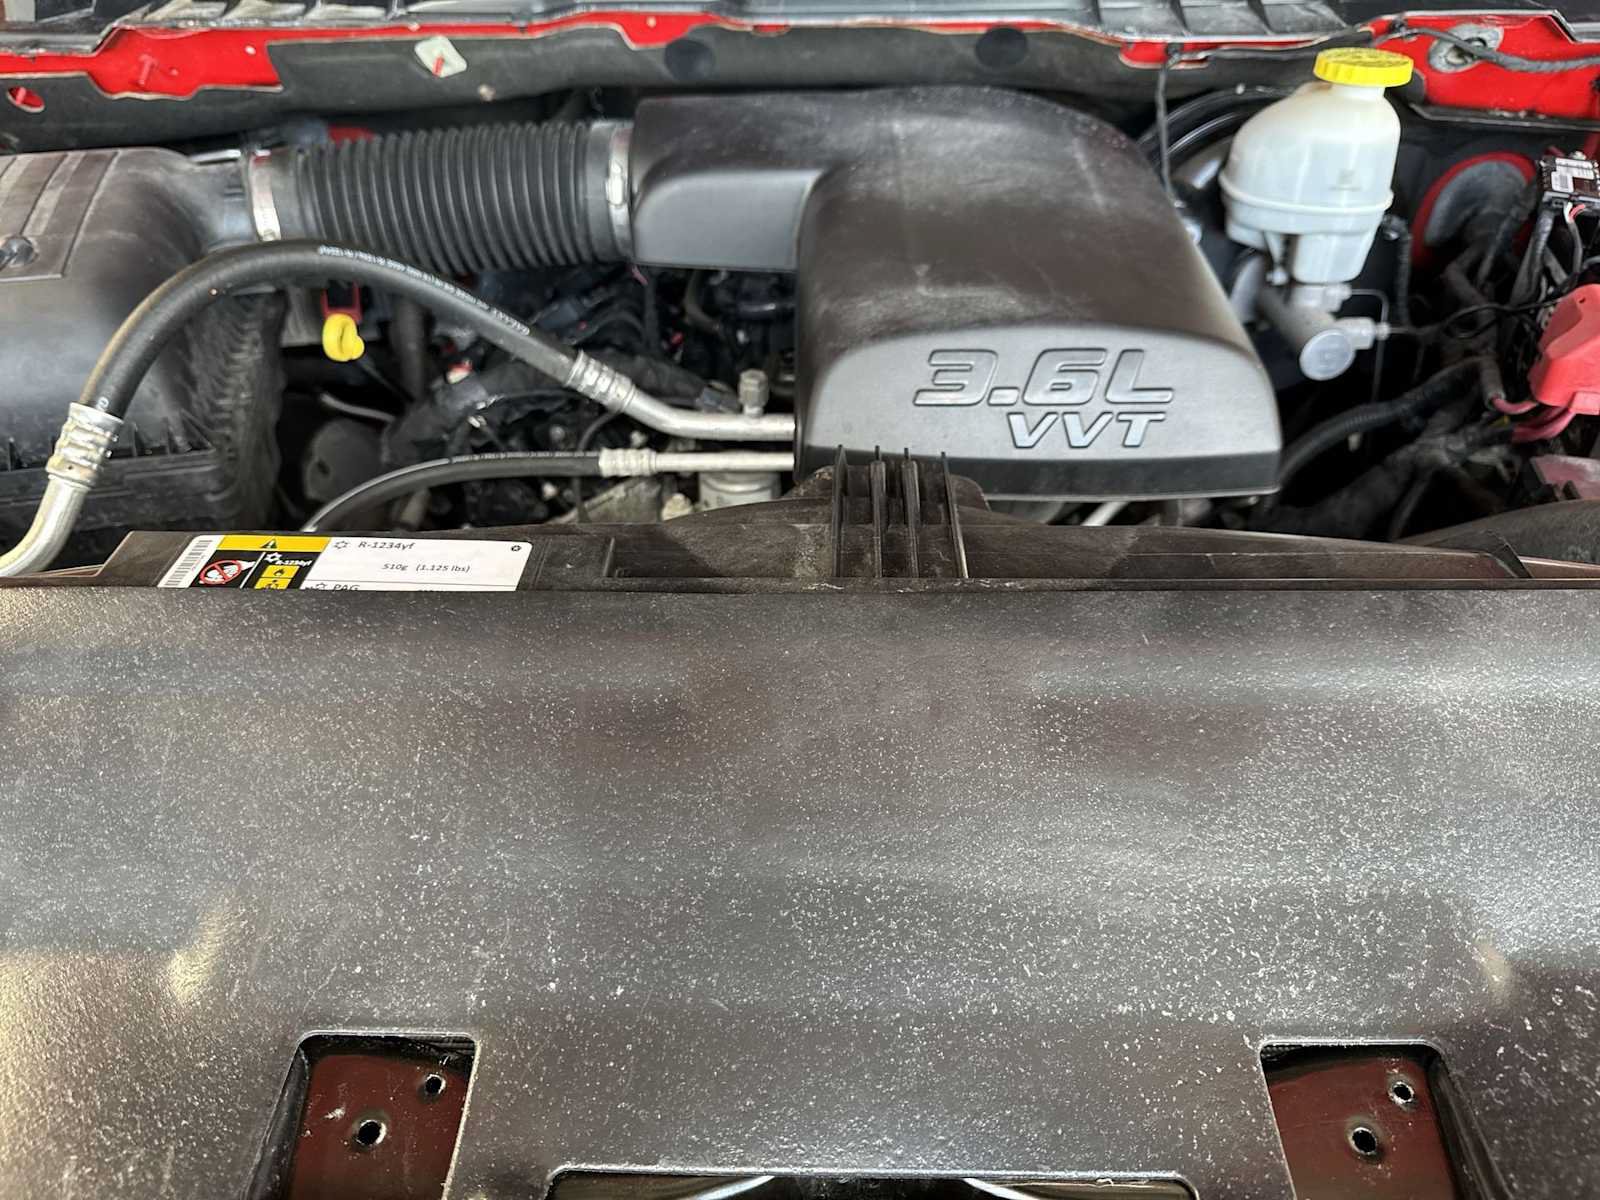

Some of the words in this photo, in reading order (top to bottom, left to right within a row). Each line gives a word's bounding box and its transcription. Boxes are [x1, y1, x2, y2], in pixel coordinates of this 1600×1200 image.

[912, 348, 1175, 406] 3.6L
[1006, 411, 1167, 449] VVT
[358, 541, 415, 550] R-1234yf
[381, 563, 409, 571] 510g
[415, 564, 449, 572] (1.125
[450, 564, 471, 573] lbs)
[332, 583, 361, 591] PAG
